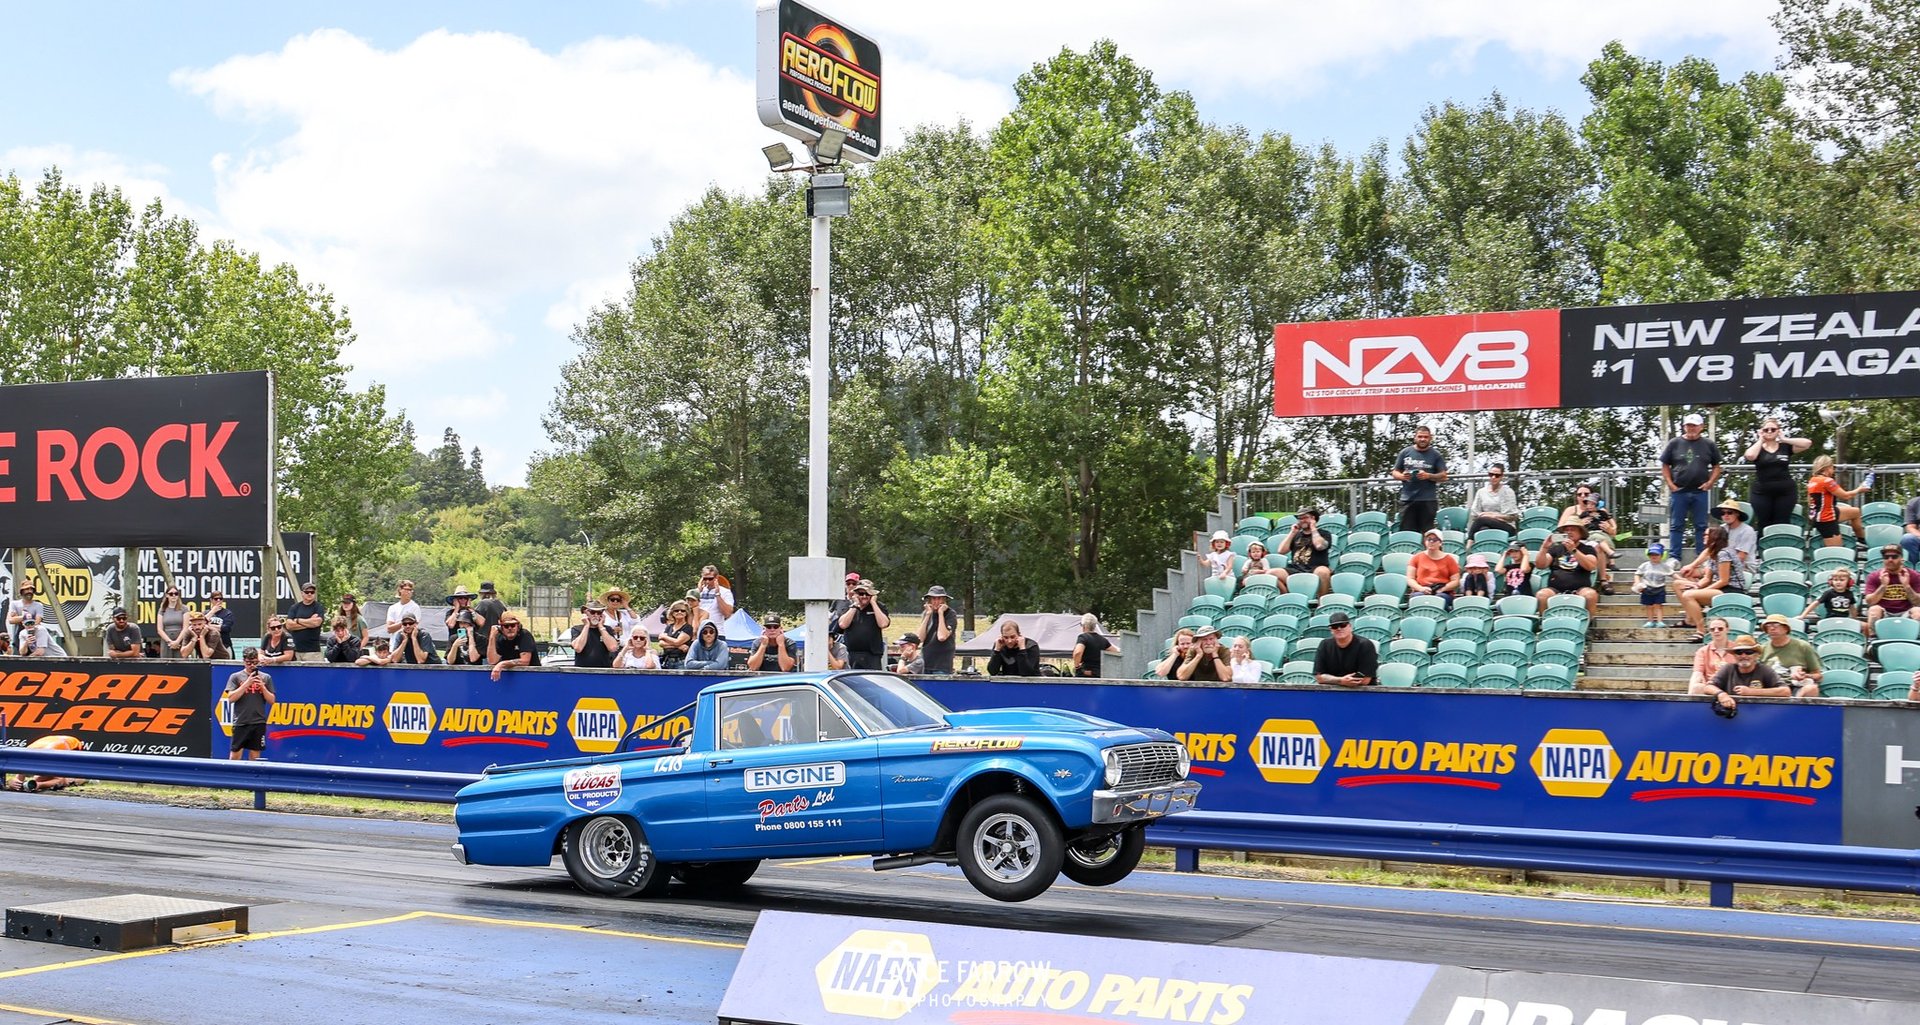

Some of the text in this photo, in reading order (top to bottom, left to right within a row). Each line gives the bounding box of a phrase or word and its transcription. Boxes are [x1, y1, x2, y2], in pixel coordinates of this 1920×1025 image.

[782, 38, 877, 112] AEROFLOW
[1593, 318, 1726, 350] NEW
[1303, 330, 1529, 388] NZV8
[1591, 359, 1634, 384] #1
[1658, 355, 1734, 382] V8
[1365, 386, 1383, 395] STRIP
[1385, 385, 1400, 394] AND
[1401, 384, 1425, 394] STREET
[1427, 383, 1463, 393] MACHINES
[1467, 382, 1526, 391] MAGAZINE
[37, 421, 241, 502] ROCK
[187, 550, 254, 574] PLAYING
[137, 575, 197, 599] RECRD
[0, 671, 189, 702] CRAP
[266, 702, 375, 729] AUTO PARTS
[391, 706, 558, 735] NAPA AUTO PARTS
[578, 712, 617, 739] NAPA
[130, 745, 145, 753] IN
[146, 745, 188, 755] SCRAP
[932, 739, 1021, 751] AEROFLOW
[1263, 736, 1518, 774] NAPA AUTO PARTS
[754, 766, 835, 786] ENGINE
[1546, 747, 1835, 789] NAPA AUTO PARTS
[572, 775, 616, 790] LUCAS
[582, 790, 618, 799] PRODUCTS
[758, 788, 835, 823] Parts Ltd
[755, 819, 842, 831] Phone 0800 155 111
[1087, 973, 1254, 1025] PARTS
